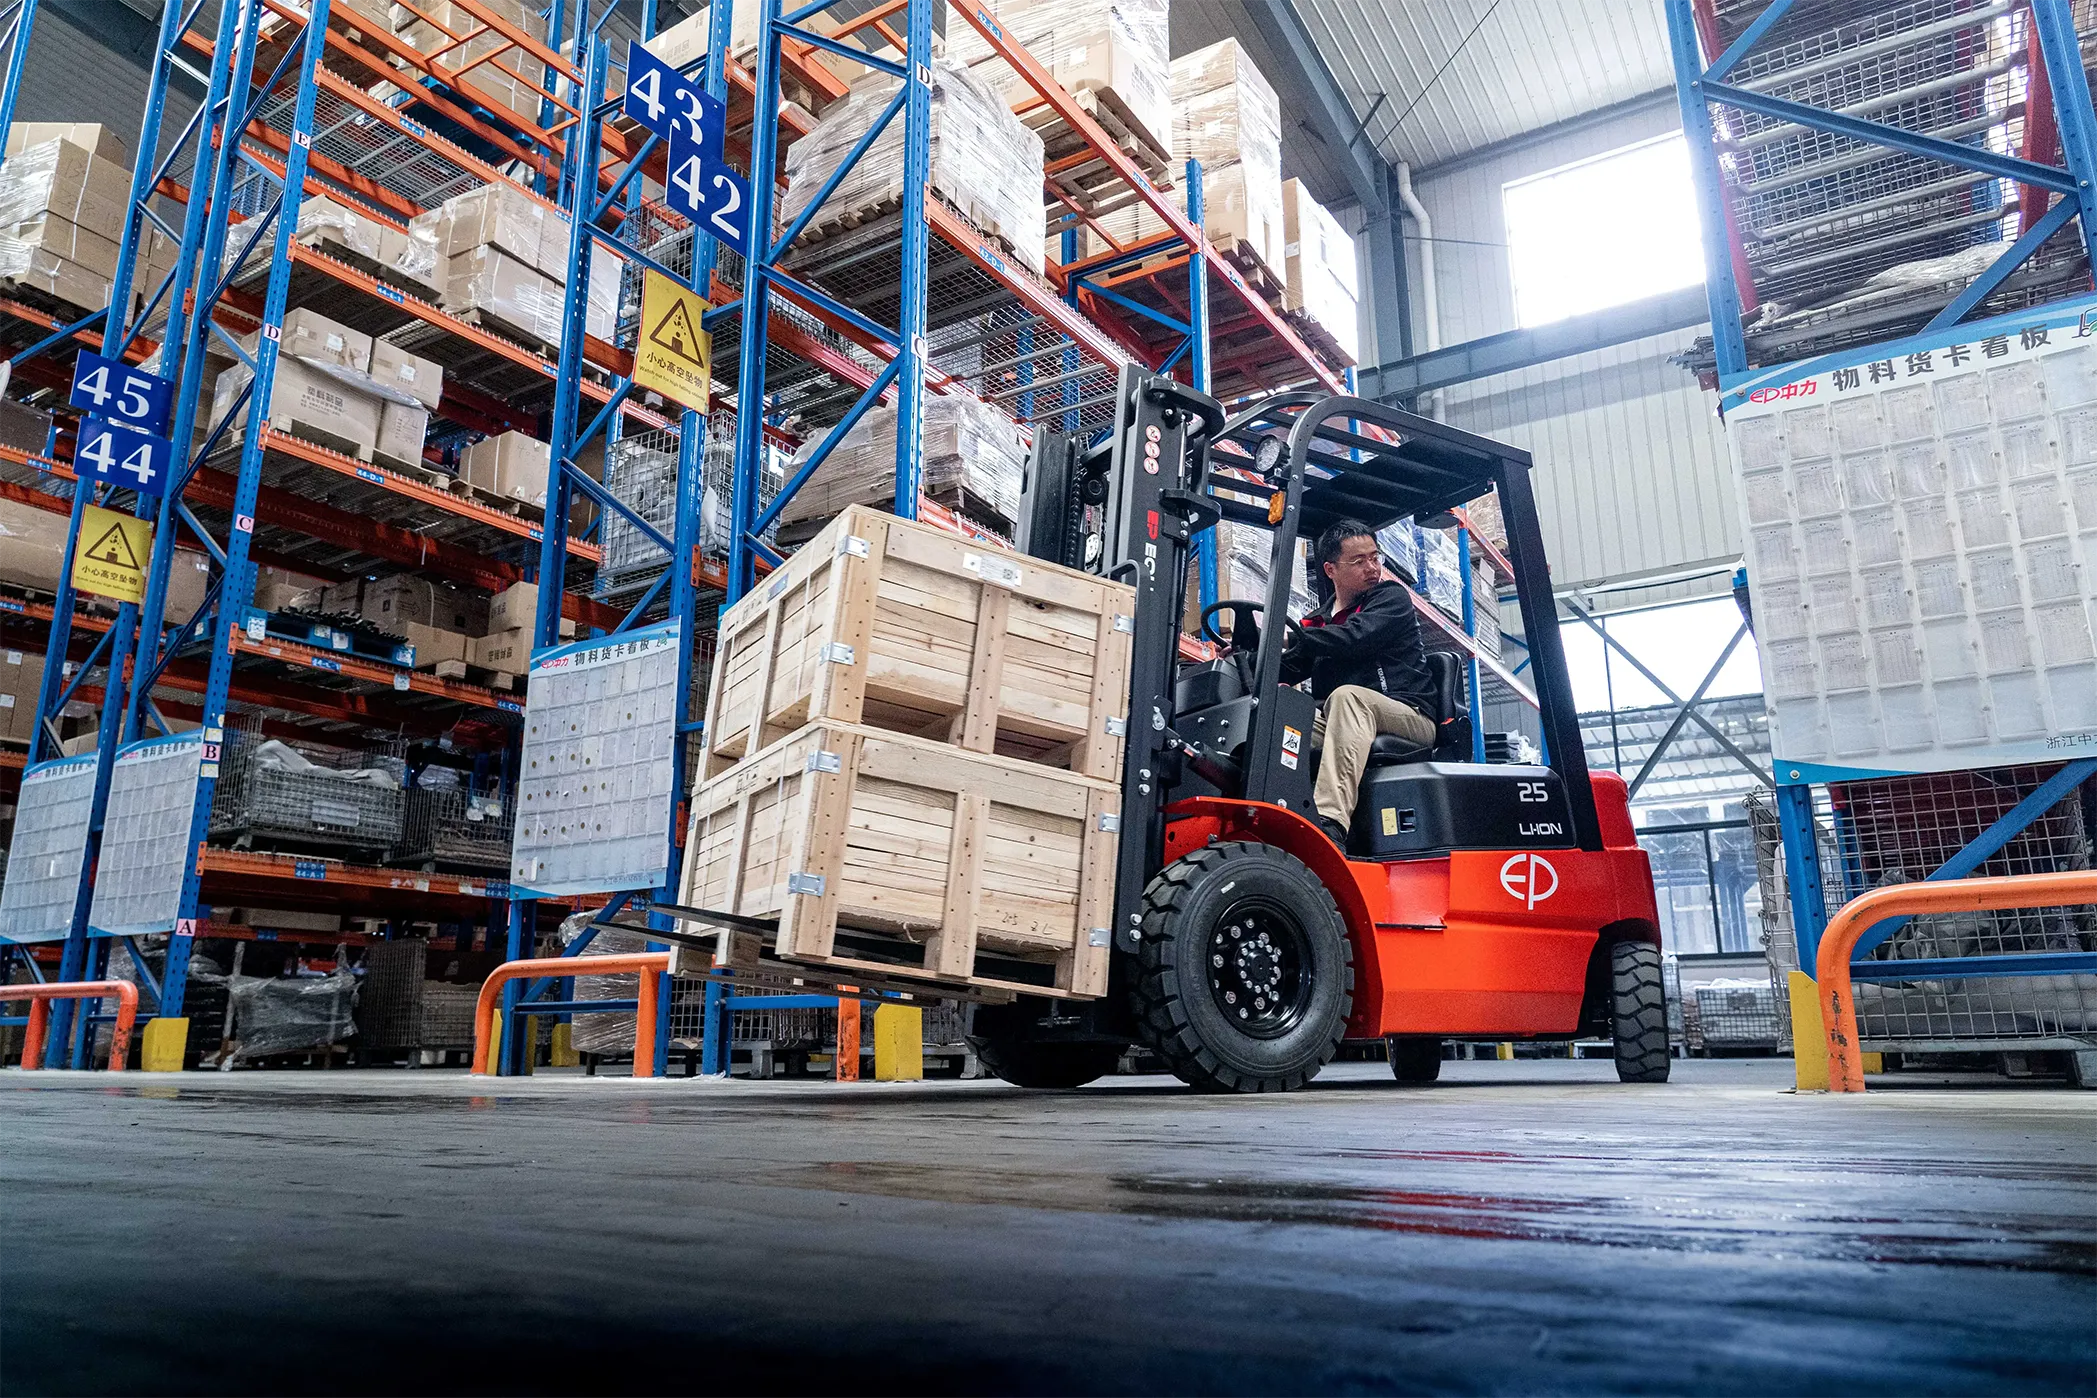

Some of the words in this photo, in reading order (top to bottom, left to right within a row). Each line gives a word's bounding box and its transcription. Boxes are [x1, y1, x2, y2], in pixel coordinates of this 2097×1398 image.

[918, 68, 931, 85] D
[630, 68, 704, 146] 43
[297, 132, 310, 148] E
[671, 154, 741, 241] 42
[979, 248, 1004, 273] 42-D-1
[266, 325, 280, 339] D
[914, 336, 925, 355] C
[1832, 323, 2052, 392] 物料货卡看板
[646, 351, 703, 389] 小心高空坠物
[77, 366, 152, 418] 45
[80, 432, 156, 484] 44
[357, 468, 384, 484] 44-D-1
[239, 516, 252, 531] C
[1147, 510, 1159, 540] EP
[81, 564, 138, 586] 小心高空坠物
[574, 637, 650, 666] 物料货卡看板
[204, 746, 217, 759] B
[1517, 782, 1549, 802] 25
[296, 870, 325, 879] 44-A-1
[1500, 853, 1559, 911] EP
[178, 921, 193, 934] A
